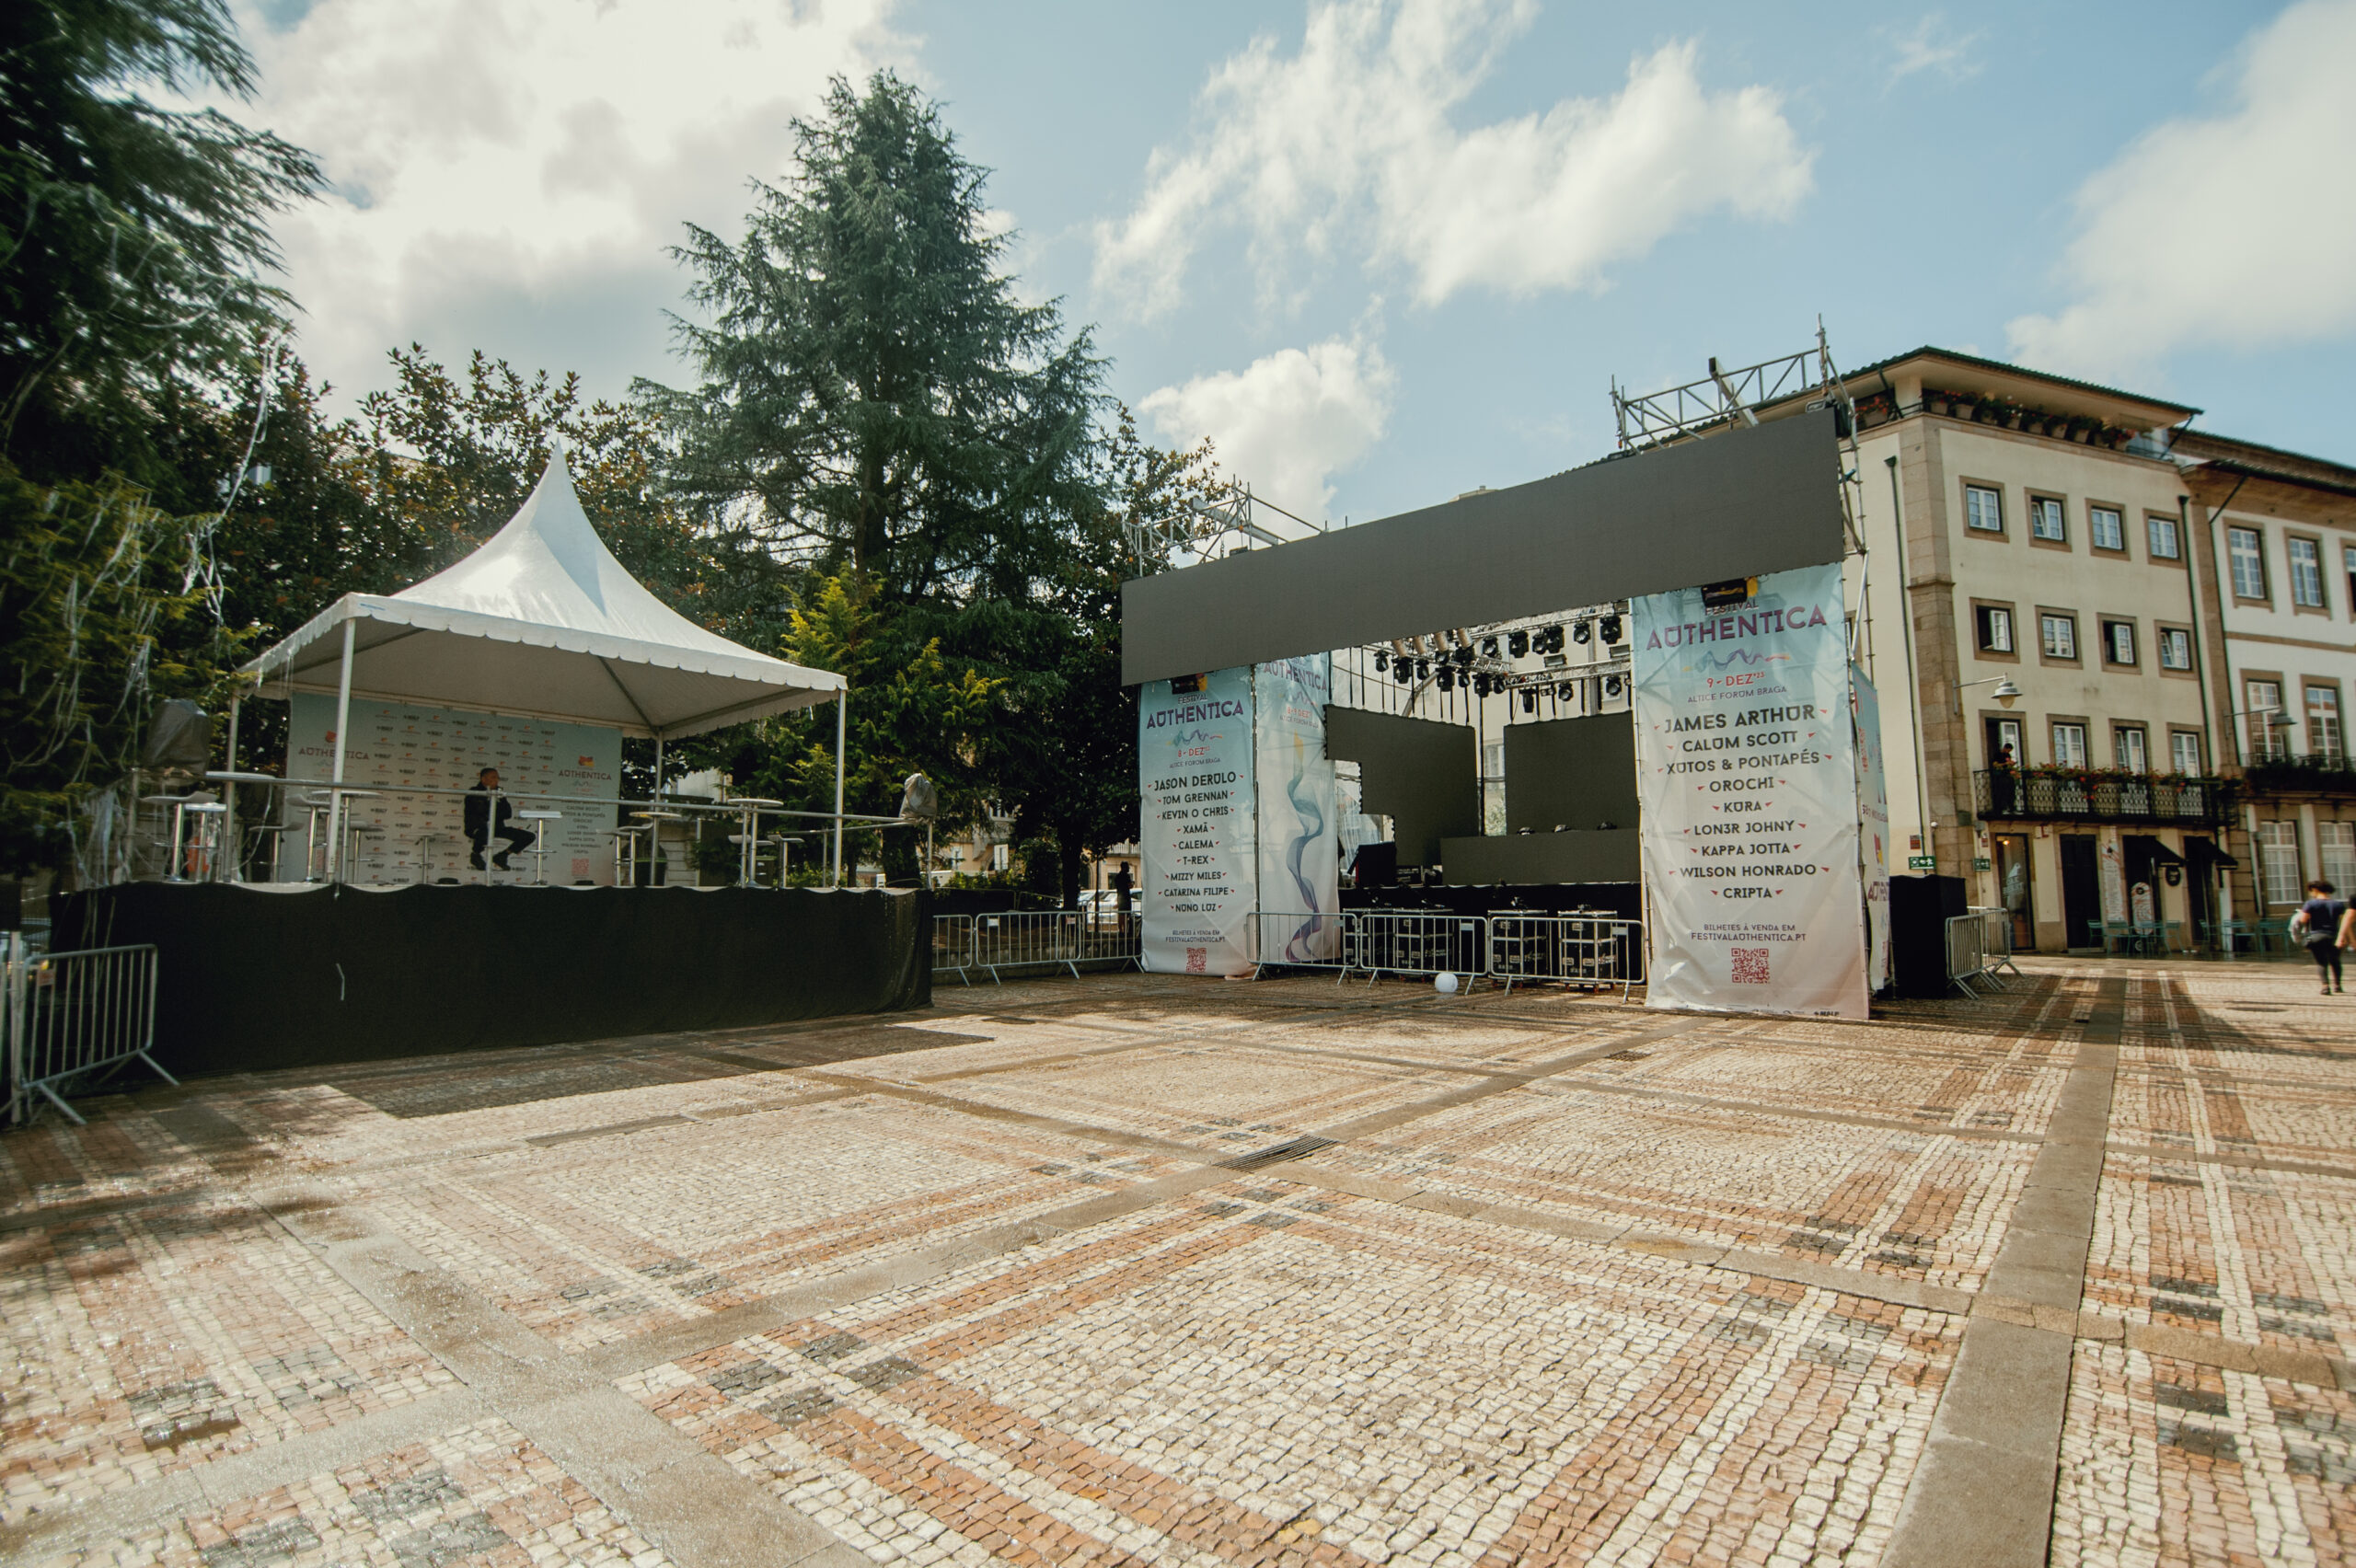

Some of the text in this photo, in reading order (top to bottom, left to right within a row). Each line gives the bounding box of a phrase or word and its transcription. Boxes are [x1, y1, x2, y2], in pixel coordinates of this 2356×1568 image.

[1704, 599, 1760, 617] FESTIVAL
[1646, 604, 1828, 651] AUTHENTICA
[1264, 661, 1327, 692] AUTHENTICA
[1707, 677, 1714, 688] 9
[1178, 694, 1208, 704] FESTIVAL
[1687, 686, 1787, 703] ALTICE FORUM BRAGA
[1147, 699, 1243, 729] AUTHENTICA
[1664, 704, 1815, 733] JAMES ARTHUR
[1682, 731, 1798, 752] CALUM SCOTT
[298, 747, 370, 760] AUTHETICA
[1667, 748, 1819, 775] XUTOS & PONTAPÉS
[559, 769, 612, 780] AUTHENTICA
[1154, 771, 1236, 791] JASON DERULO
[1709, 777, 1774, 792] OROCHI
[1162, 790, 1228, 805] TOM GRENNAN
[1162, 806, 1229, 820] KEVIN O CHRIS
[1724, 801, 1762, 813] KURA
[1183, 822, 1208, 834] XAMÃ
[1694, 820, 1796, 836] LON3R JOHNY
[1178, 839, 1214, 849] CALEMA
[1702, 843, 1791, 857] KAPPA JOTTA
[1183, 856, 1208, 865] T-REX
[1171, 871, 1221, 881] MIZZY MILES
[1680, 864, 1817, 878] WILSON HONRADO
[1163, 887, 1229, 896] CATARINA FILIPE
[1723, 887, 1773, 899] CRIPTA
[1175, 904, 1217, 912] NUNO LUZ
[1691, 932, 1807, 941] FESTIVALAUTHENTICA.PT
